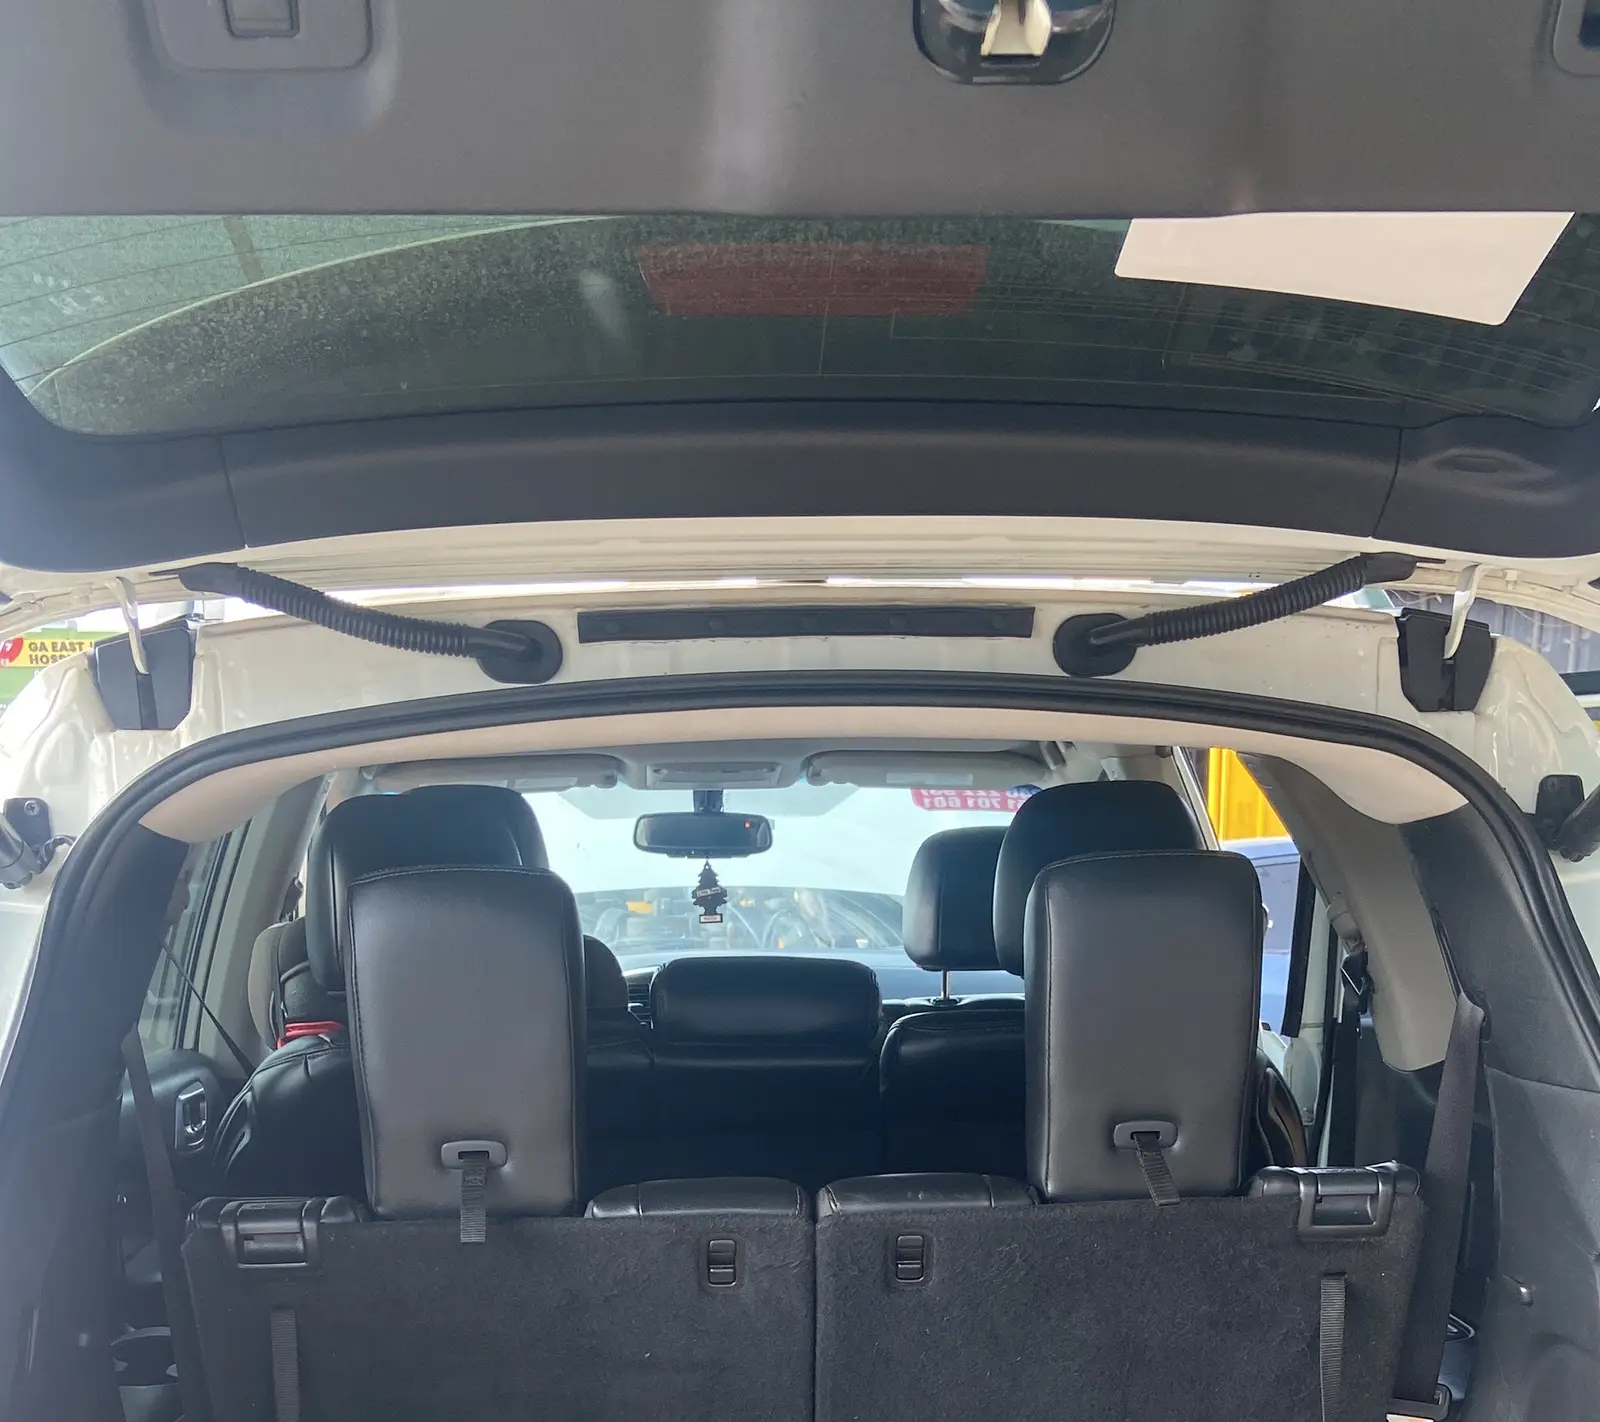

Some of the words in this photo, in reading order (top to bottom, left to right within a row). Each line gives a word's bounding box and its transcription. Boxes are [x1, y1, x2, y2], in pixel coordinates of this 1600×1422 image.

[28, 641, 48, 652] GA
[51, 641, 84, 652] EAST
[29, 654, 71, 664] HOSP
